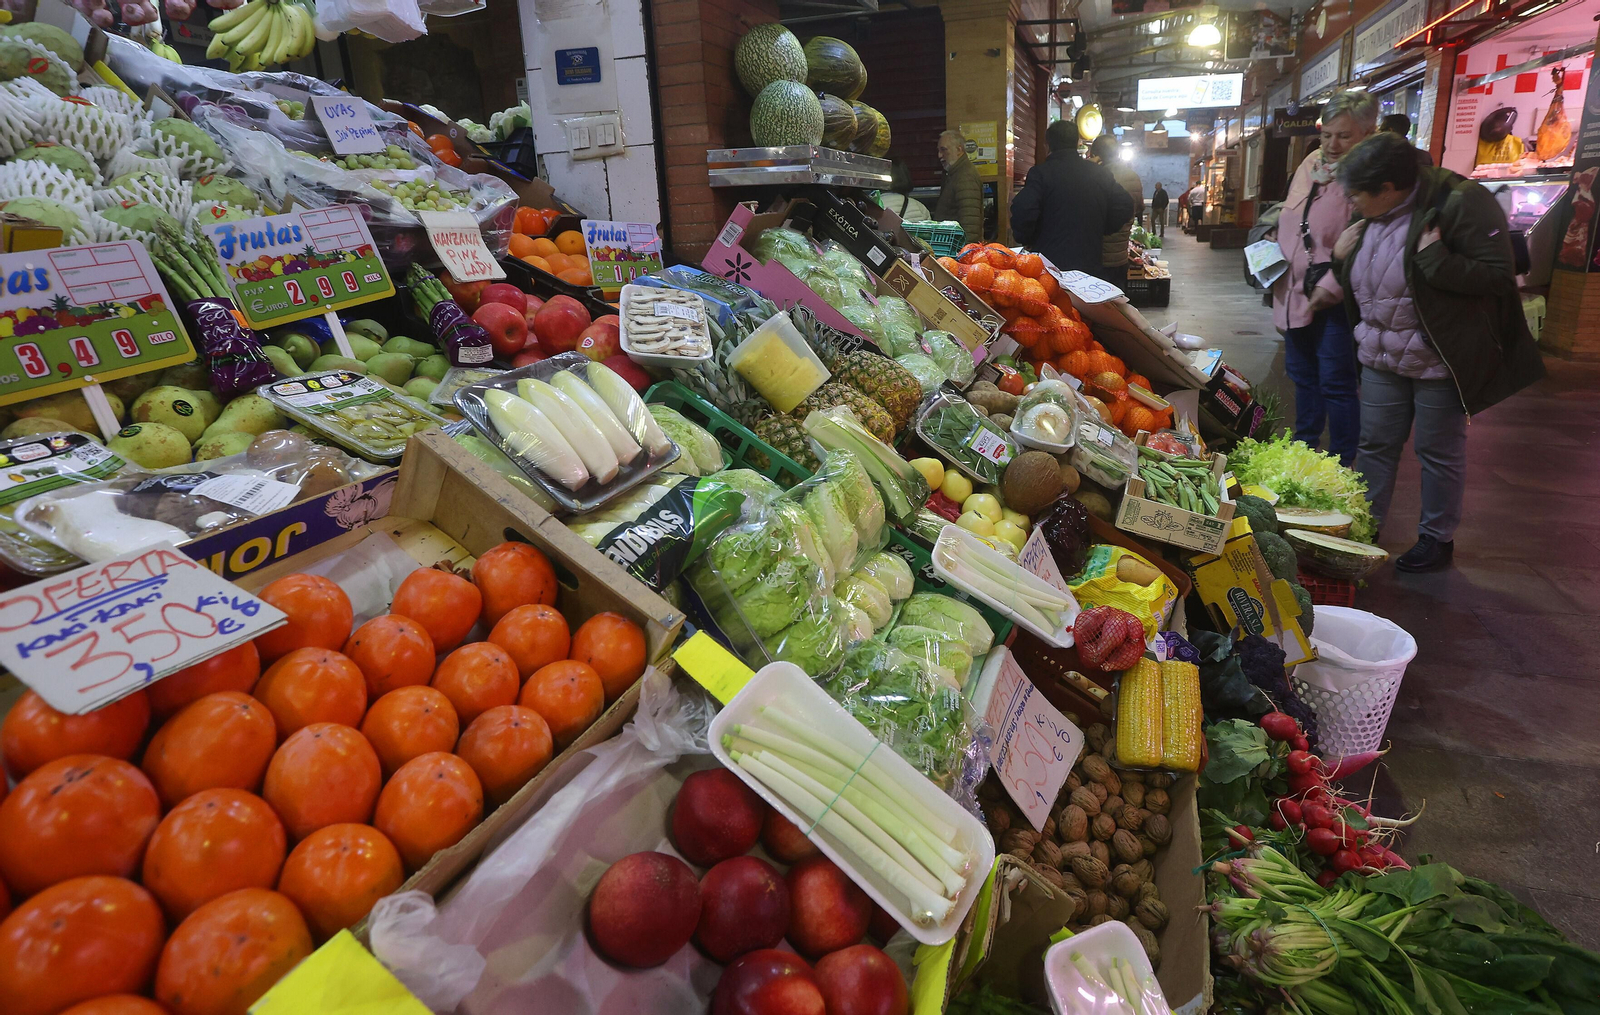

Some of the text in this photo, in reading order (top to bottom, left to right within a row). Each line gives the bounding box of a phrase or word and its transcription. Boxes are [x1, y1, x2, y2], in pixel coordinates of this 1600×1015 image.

[324, 103, 356, 119] UVAS
[828, 207, 859, 239] EXÓTICA
[214, 221, 303, 260] Frutas
[433, 231, 481, 247] MANZANA
[587, 222, 627, 244] Frutas
[446, 249, 479, 265] PINK
[462, 260, 493, 277] LADY
[150, 332, 174, 343] KILO
[0, 549, 198, 633] OFERTA
